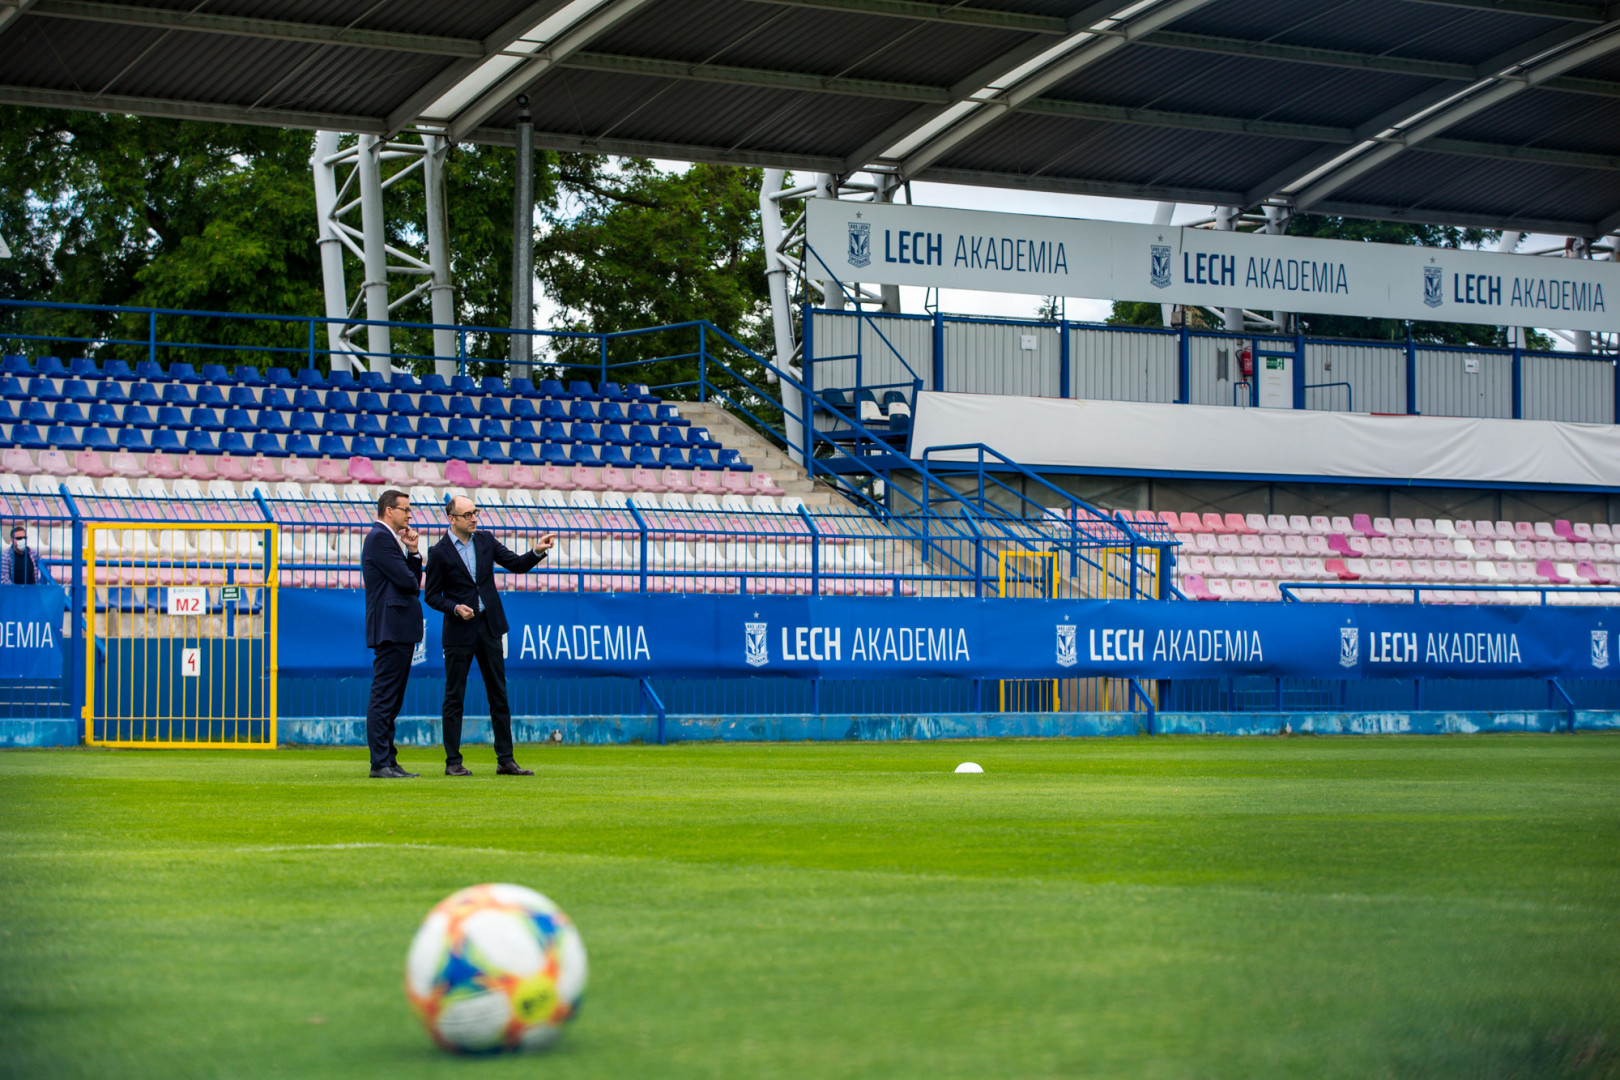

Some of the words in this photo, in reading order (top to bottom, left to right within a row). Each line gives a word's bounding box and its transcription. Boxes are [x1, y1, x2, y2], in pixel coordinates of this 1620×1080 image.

[884, 229, 942, 266] LECH
[953, 234, 1068, 275] AKADEMIA
[1183, 251, 1235, 286] LECH
[1245, 256, 1349, 294] AKADEMIA
[1453, 273, 1501, 306] LECH
[1510, 277, 1605, 312] AKADEMIA
[176, 598, 199, 611] M2
[520, 624, 650, 660] AKADEMIA
[782, 627, 841, 661] LECH
[851, 627, 970, 661] AKADEMIA
[1089, 629, 1144, 661] LECH
[1152, 630, 1263, 662] AKADEMIA
[1369, 631, 1418, 662] LECH
[1425, 633, 1522, 663] AKADEMIA
[188, 652, 195, 672] 4
